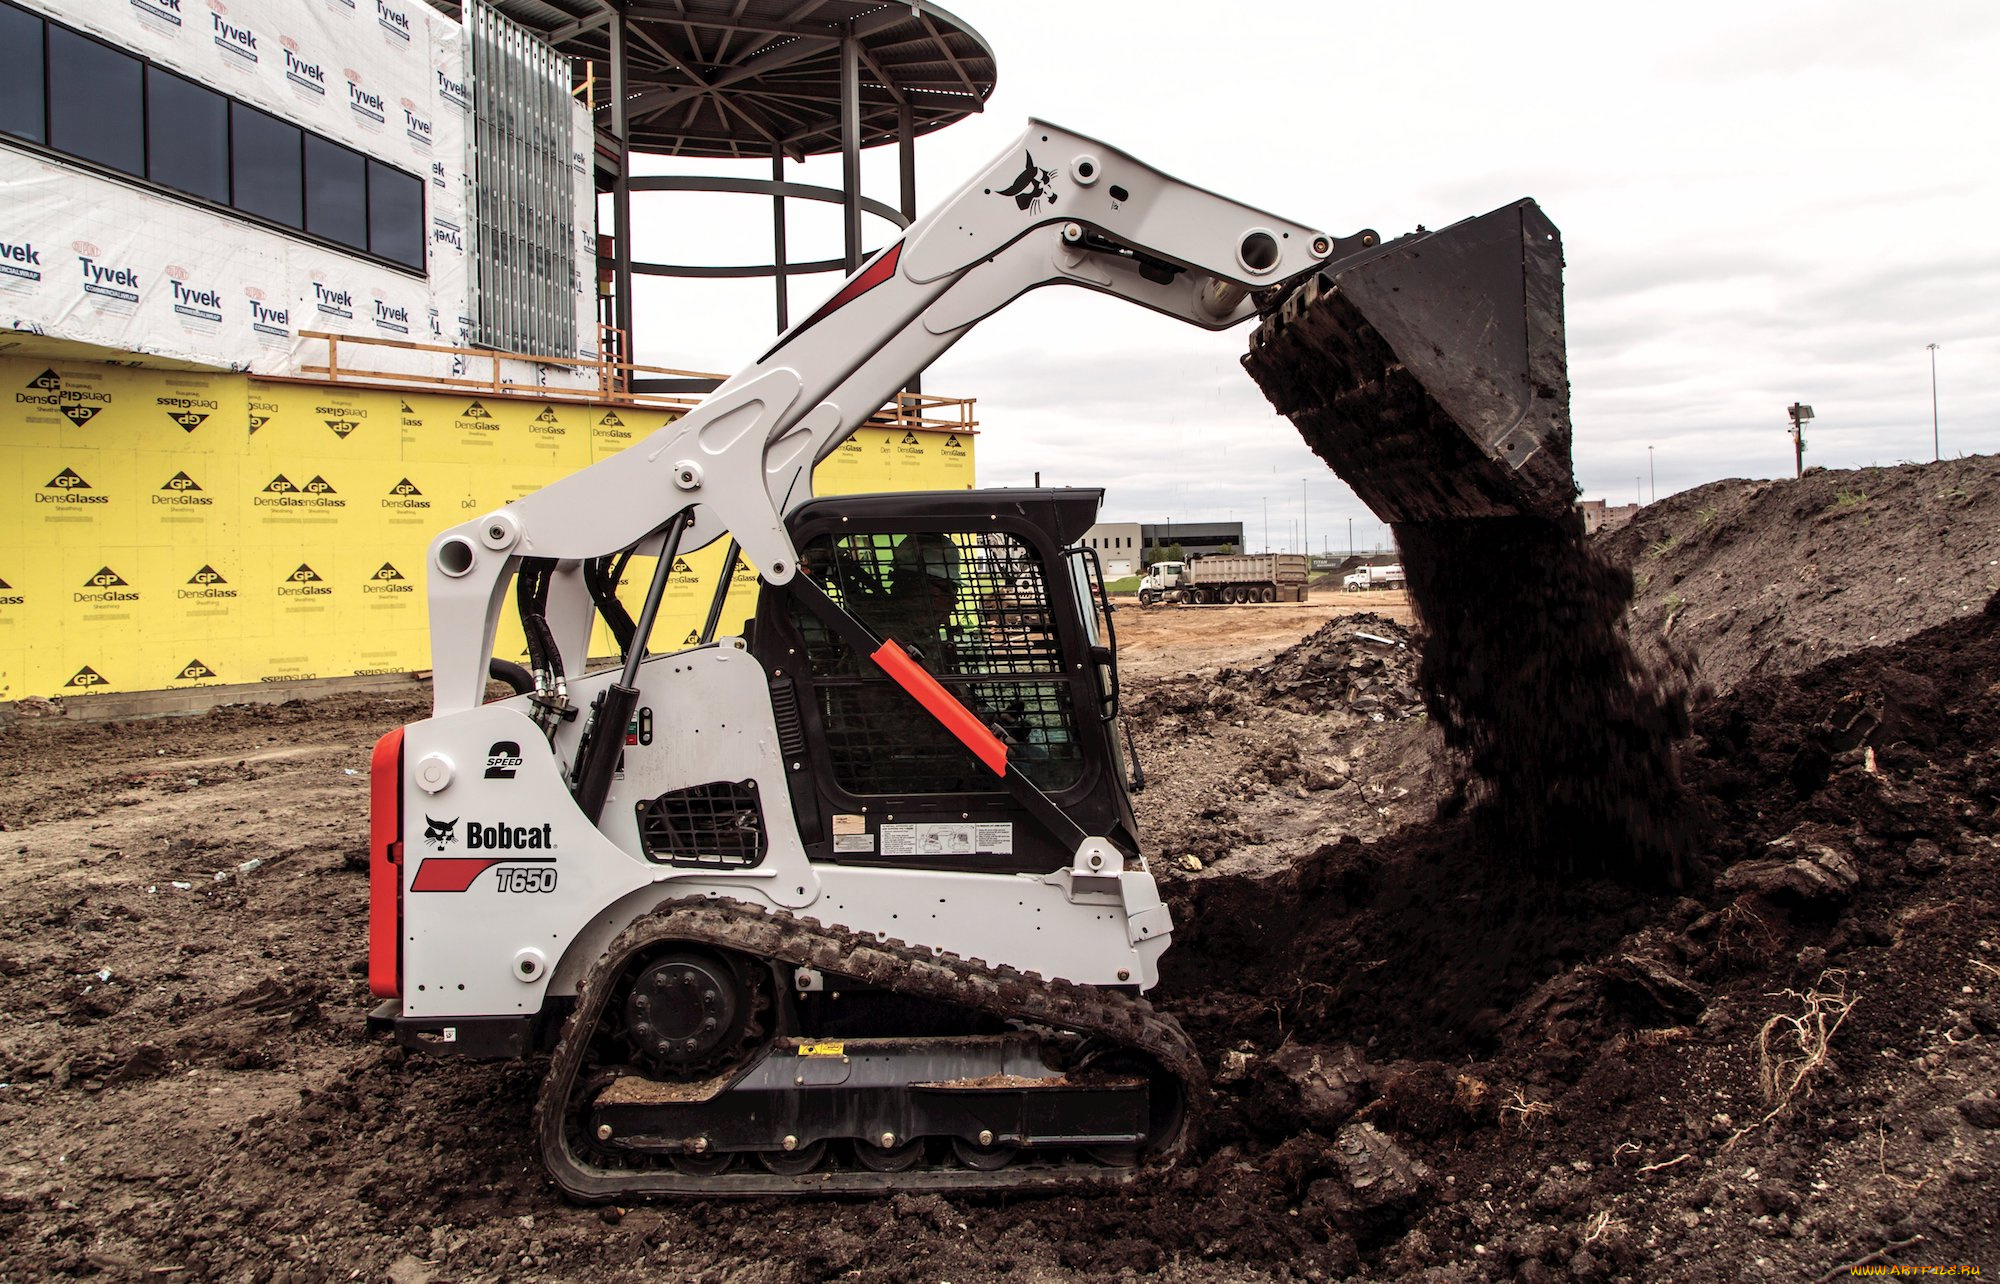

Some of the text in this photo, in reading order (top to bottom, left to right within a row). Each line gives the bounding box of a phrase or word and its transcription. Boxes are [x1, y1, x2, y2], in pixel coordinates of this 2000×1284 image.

[376, 0, 409, 30] Tyvek
[211, 12, 258, 50] Tyvek
[283, 49, 325, 83] Tyvek
[348, 81, 384, 112] Tyvek
[0, 243, 41, 266] vek
[79, 256, 139, 288] Tyvek
[170, 280, 221, 309] Tyvek
[313, 282, 352, 307] Tyvek
[374, 300, 408, 323] Tyvek
[60, 390, 112, 404] DensGla
[157, 397, 218, 410] DensGlass
[67, 407, 93, 419] GP
[315, 406, 368, 419] DensGlass
[468, 407, 485, 417] GP
[178, 414, 201, 425] GP
[604, 416, 619, 425] GP
[333, 422, 353, 433] GP
[455, 420, 500, 431] DensGlass
[592, 429, 632, 438] DensGlass
[55, 476, 80, 487] GP
[170, 479, 193, 490] GP
[270, 481, 291, 491] GP
[308, 482, 328, 492] GP
[396, 485, 415, 494] GP
[151, 494, 214, 506] DensGlass
[302, 498, 346, 507] ensGlass
[381, 499, 431, 508] DensGlass
[673, 563, 687, 572] GP
[195, 573, 219, 583] GP
[293, 571, 314, 581] GP
[378, 569, 397, 579] GP
[93, 574, 118, 586] GP
[177, 588, 238, 599] DensGlass
[277, 586, 333, 596] DensGlass
[363, 584, 413, 593] DensGlass
[73, 591, 140, 603] DensGlass
[184, 666, 206, 678] GP
[73, 673, 99, 686] GP
[484, 741, 520, 779] 2
[486, 758, 523, 766] SPEED
[467, 822, 553, 849] Bobcat
[496, 867, 558, 893] T650
